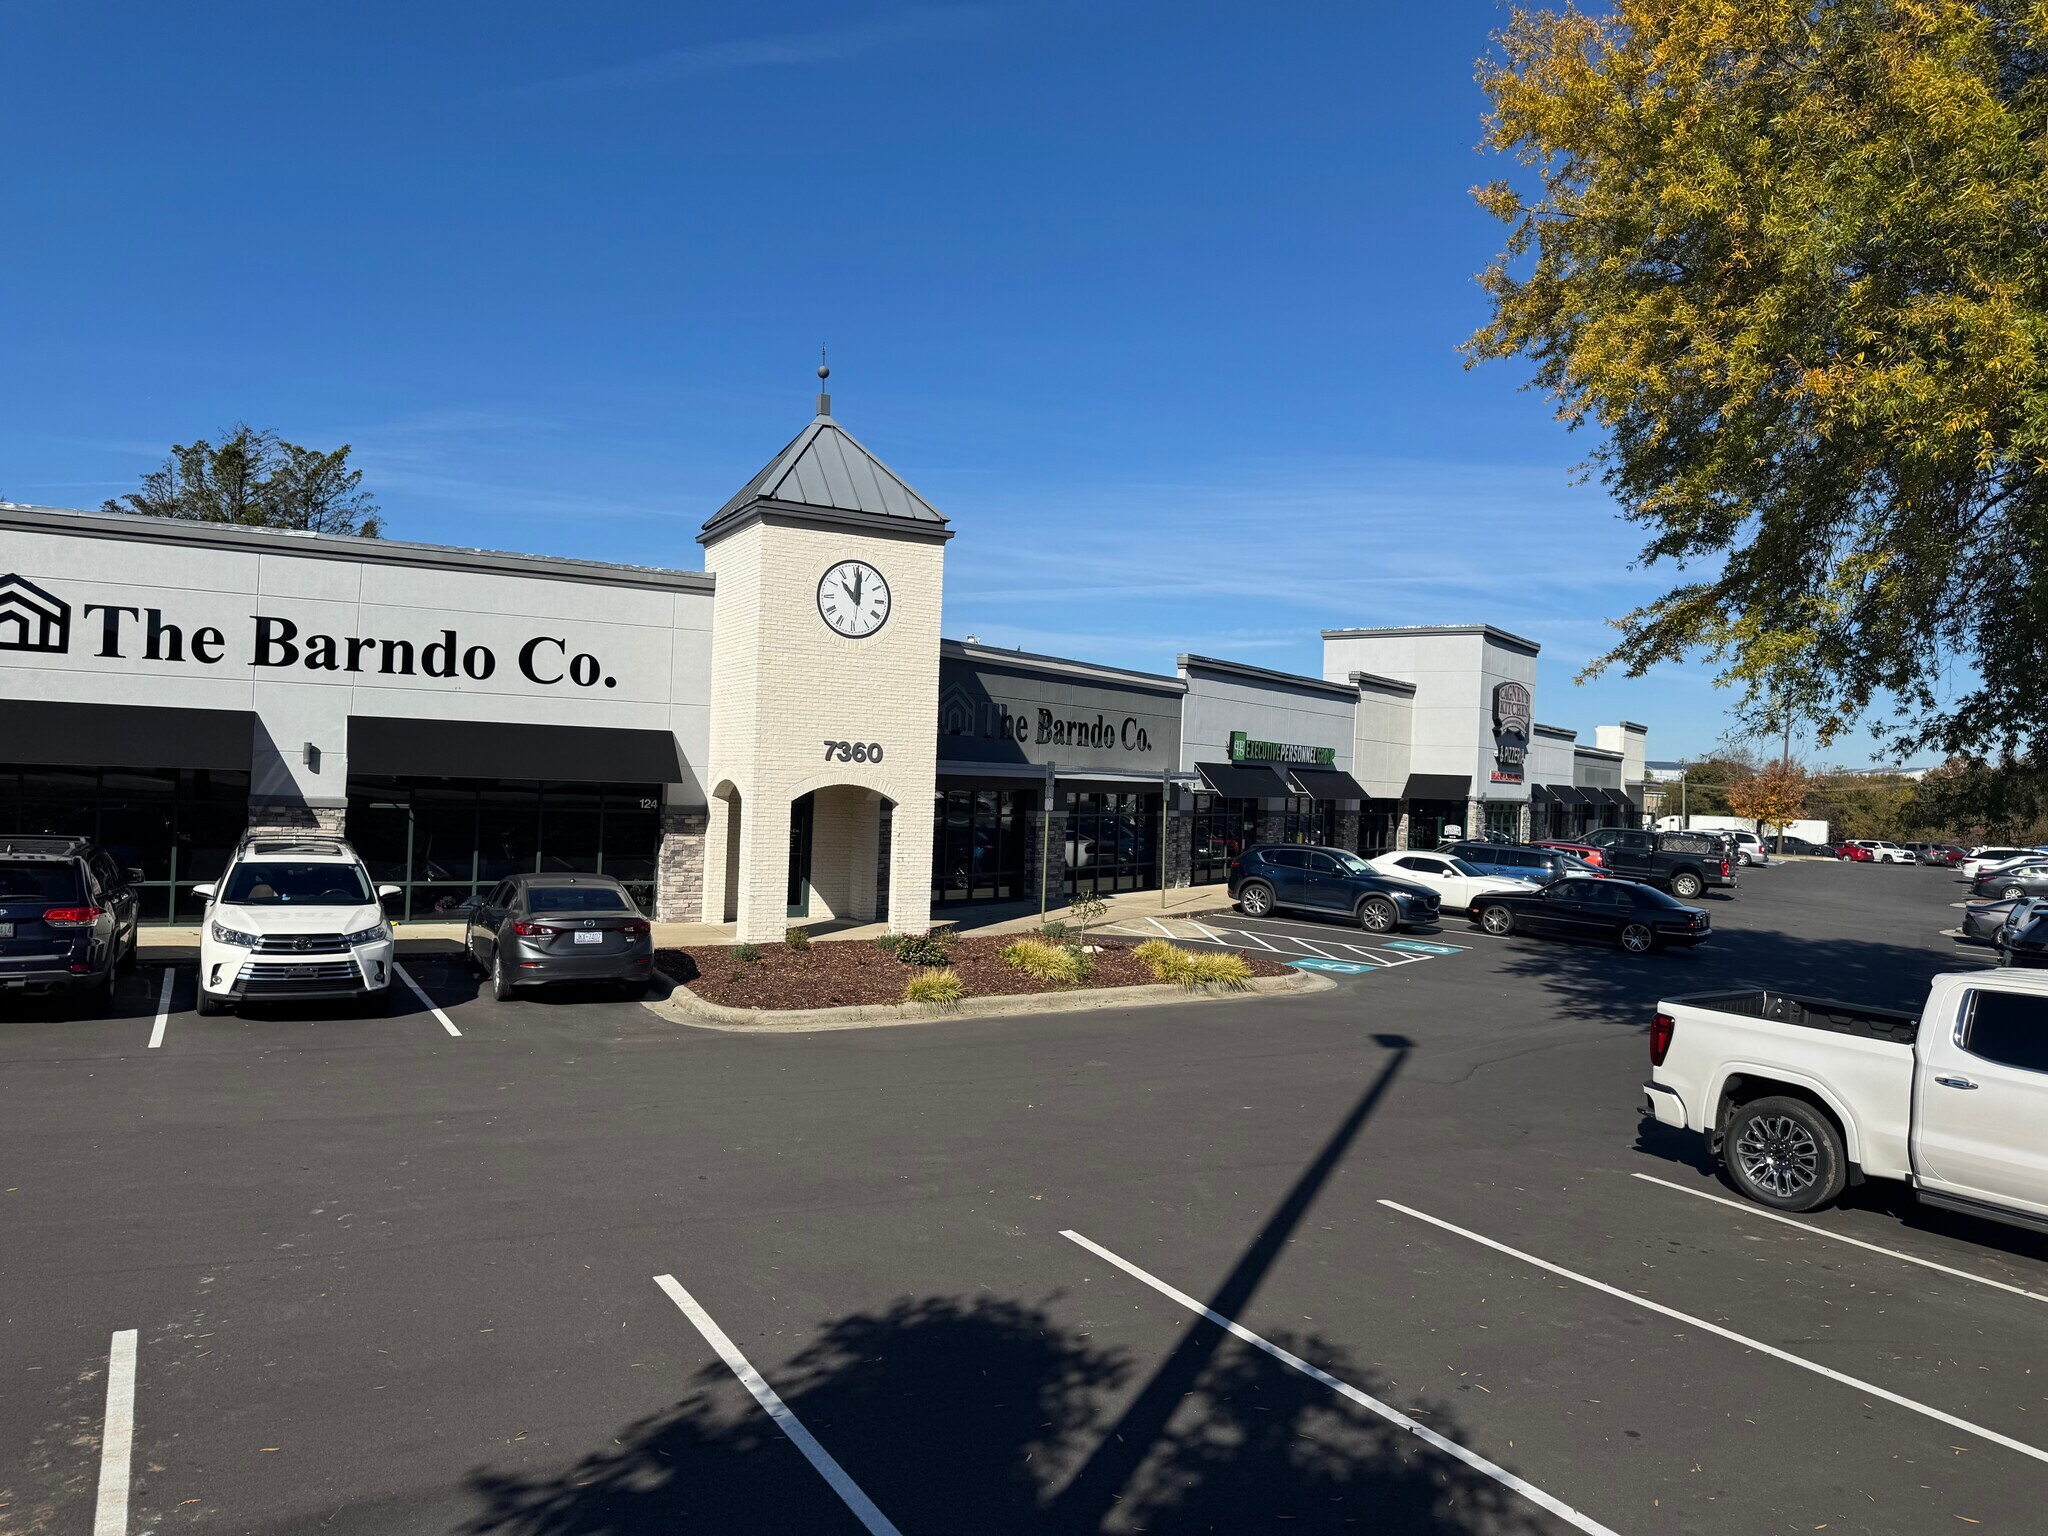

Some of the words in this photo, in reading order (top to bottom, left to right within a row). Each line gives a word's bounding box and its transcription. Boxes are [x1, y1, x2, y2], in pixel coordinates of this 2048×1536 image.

[84, 604, 225, 664] The
[247, 615, 496, 680] Barndo
[518, 636, 617, 688] Co.
[980, 702, 1029, 743] The
[1035, 707, 1115, 749] Barndo
[1121, 717, 1152, 752] Co.
[823, 740, 884, 764] 7360
[1246, 741, 1280, 760] EXECUTIVE
[1280, 745, 1317, 763] PERSONNEL
[639, 798, 658, 809] 124
